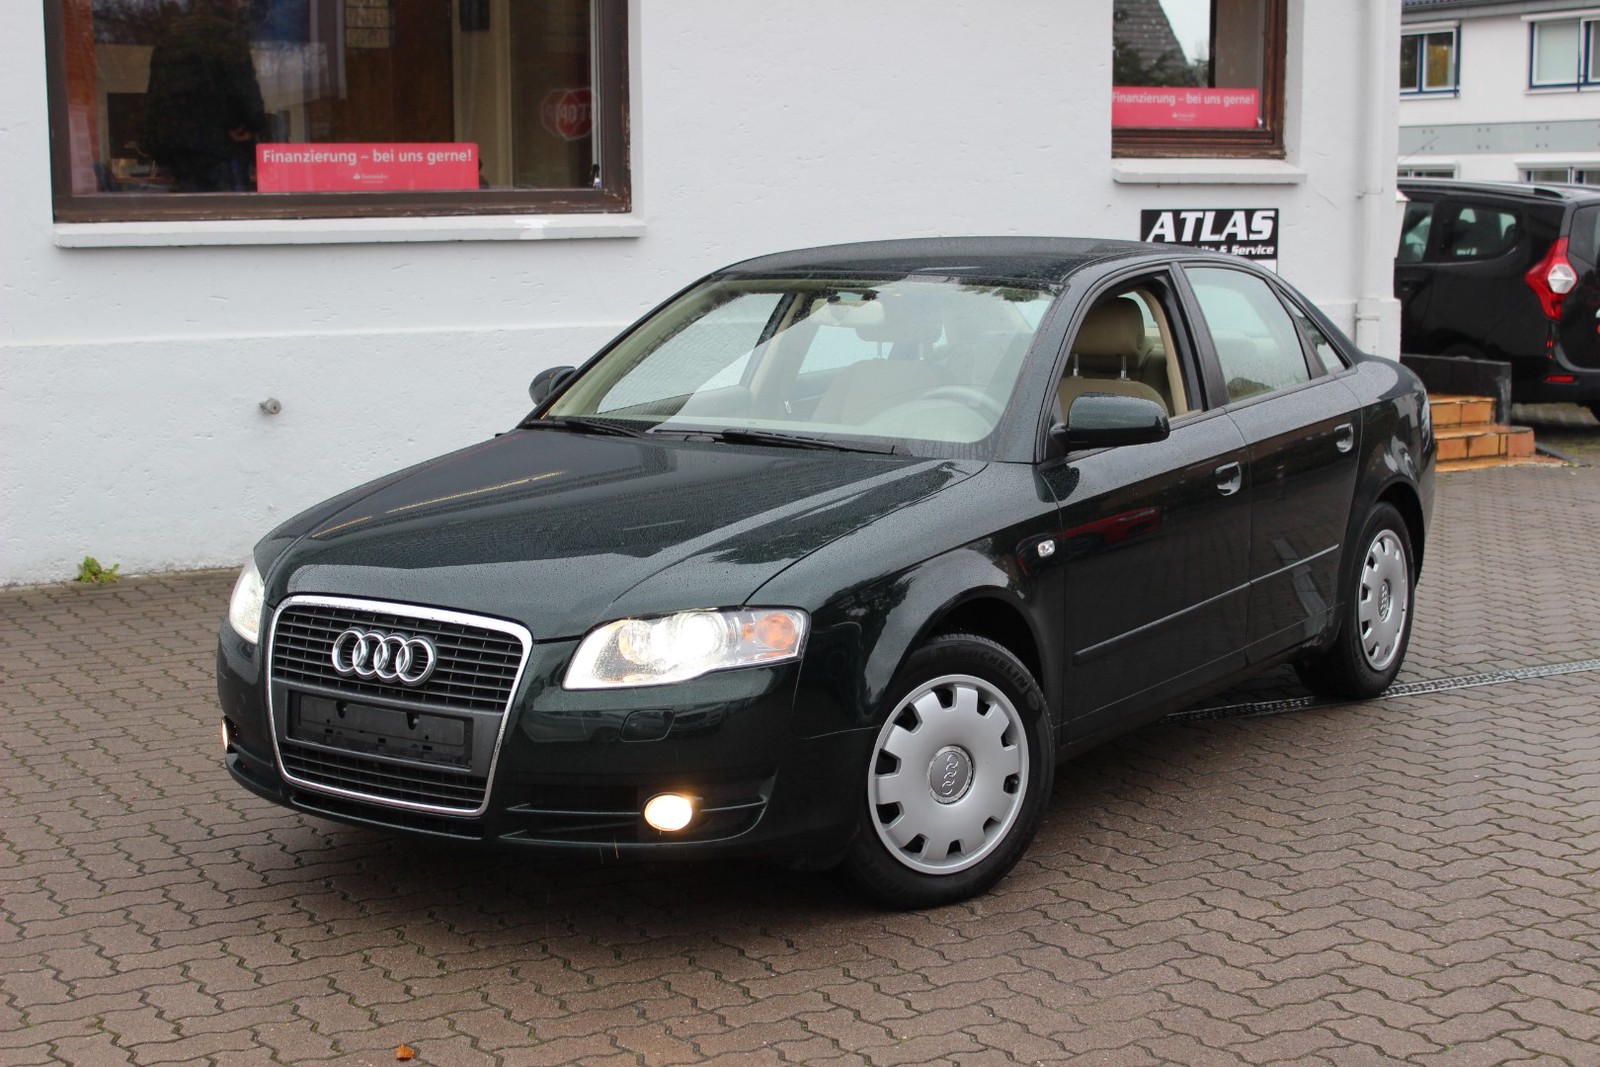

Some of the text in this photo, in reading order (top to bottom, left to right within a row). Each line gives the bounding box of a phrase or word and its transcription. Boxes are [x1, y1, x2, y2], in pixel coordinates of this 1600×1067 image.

[1111, 91, 1176, 107] Finanzierung
[1186, 91, 1202, 105] bei
[1203, 95, 1221, 105] uns
[1223, 94, 1255, 108] gerne!
[262, 148, 357, 166] Finanzierung
[372, 149, 394, 163] bei
[398, 151, 423, 163] uns
[426, 149, 472, 166] gerne!
[1145, 210, 1275, 242] ATLAS
[1231, 244, 1275, 256] Service
